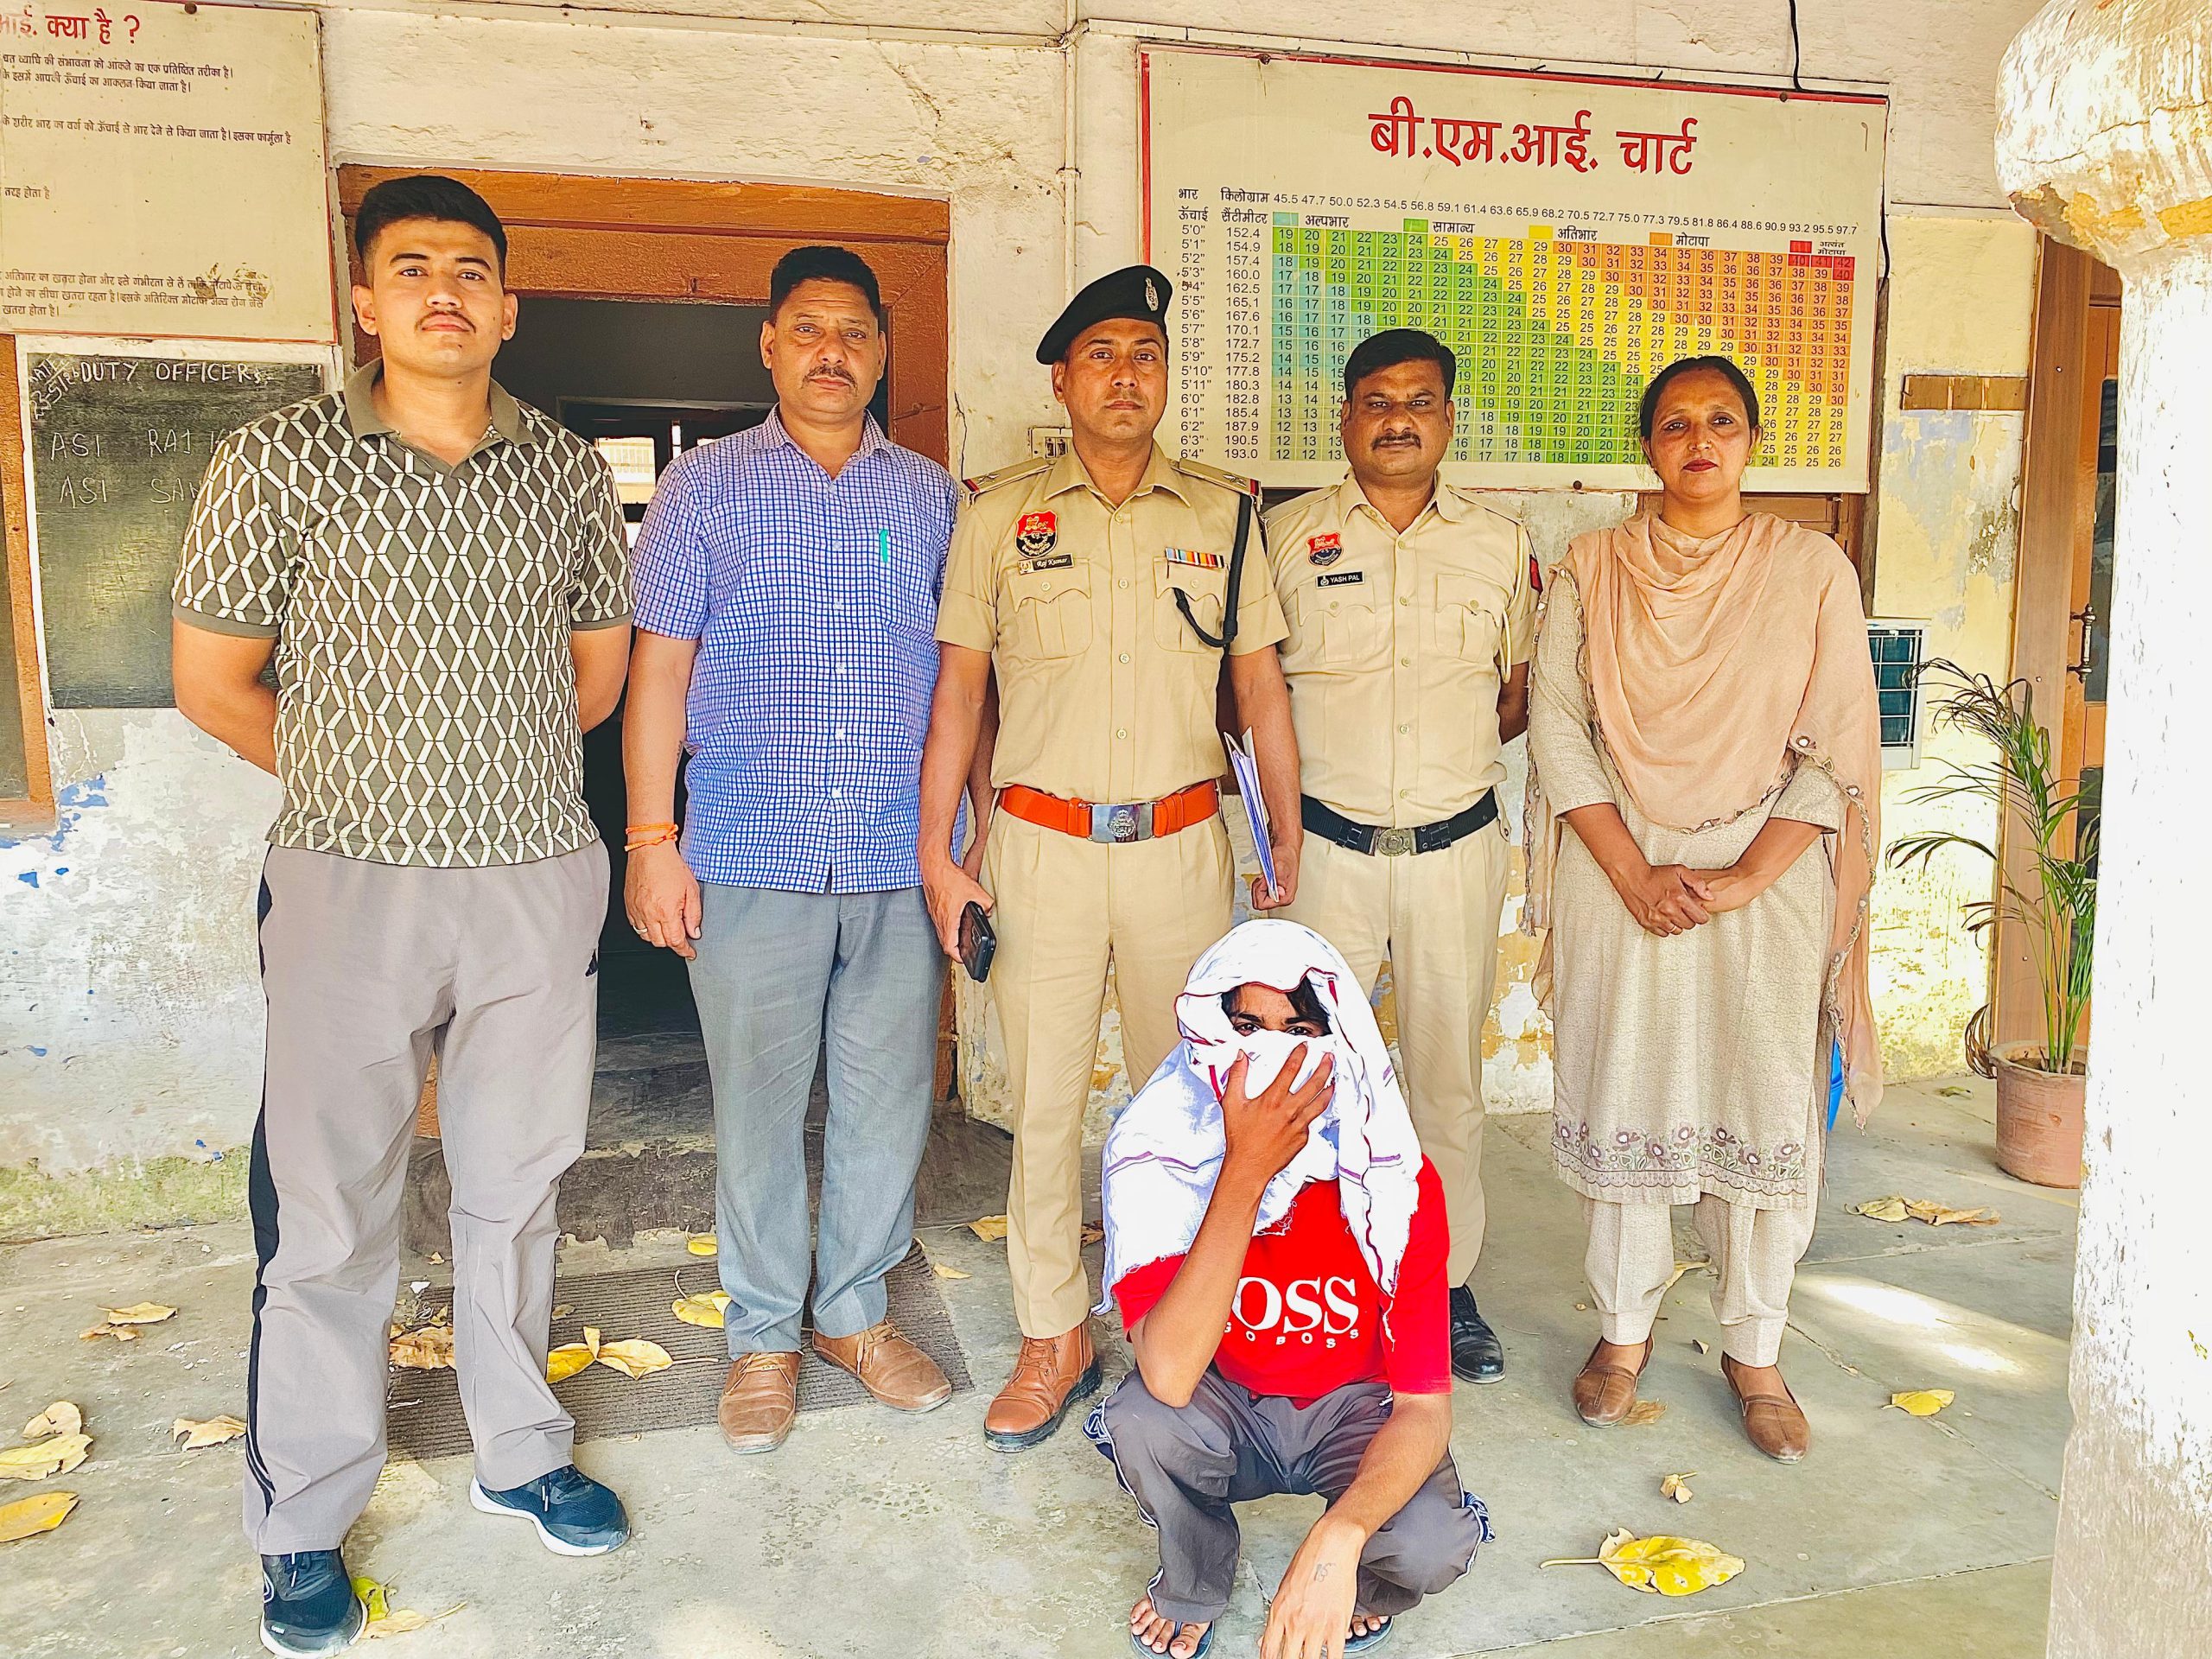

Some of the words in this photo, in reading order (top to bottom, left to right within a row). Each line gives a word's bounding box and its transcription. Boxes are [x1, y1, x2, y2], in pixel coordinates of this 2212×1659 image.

[45, 15, 90, 40] क्या
[94, 8, 112, 44] है
[124, 14, 140, 44] ?
[44, 53, 54, 66] की
[135, 63, 144, 73] का
[148, 65, 161, 74] एक
[197, 65, 221, 78] तरीका
[136, 77, 156, 90] किया
[159, 82, 178, 92] जाता
[166, 124, 173, 137] से
[176, 124, 196, 137] किया
[199, 130, 219, 139] जाता
[233, 132, 254, 143] इसका
[285, 130, 292, 145] है
[1368, 96, 1599, 173] बी.एम.आई.
[1616, 118, 1698, 175] चार्ट
[1179, 188, 1198, 200] भार
[1220, 188, 1270, 203] किलोग्राम
[1274, 194, 1298, 204] 45.5
[1301, 195, 1325, 206] 47.7
[1329, 196, 1353, 207] 50.0
[1357, 198, 1380, 208] 52.3
[1383, 200, 1408, 210] 54.5
[1410, 201, 1434, 211] 56.8
[1437, 202, 1459, 213] 59.1
[1464, 204, 1486, 214] 61.4
[1490, 206, 1512, 215] 63.6
[1516, 207, 1539, 217] 65.9
[1541, 208, 1564, 219] 68.2
[1567, 210, 1590, 220] 70.5
[1592, 212, 1615, 222] 72.7
[1618, 213, 1640, 223] 75.0
[1643, 214, 1665, 225] 77.3
[1668, 216, 1689, 226] 79.5
[1692, 217, 1713, 227] 81.8
[1716, 219, 1738, 229] 86.4
[1741, 220, 1762, 230] 88.6
[1764, 221, 1786, 232] 90.9
[1789, 223, 1810, 232] 93.2
[1813, 224, 1834, 234] 95.5
[1836, 226, 1857, 235] 97.7
[1305, 214, 1350, 228] अल्पभार
[1432, 221, 1476, 234] सामान्य
[1557, 226, 1599, 241] अतिभार
[1675, 232, 1710, 247] मोटापा
[1226, 227, 1260, 238] 152.4
[1279, 228, 1294, 238] 19
[1305, 230, 1319, 240] 20
[1332, 232, 1345, 242] 21
[1357, 232, 1371, 243] 22
[1382, 234, 1397, 244] 23
[1408, 235, 1423, 245] 24
[1433, 236, 1448, 246] 25
[1459, 238, 1473, 248] 26
[1484, 239, 1498, 249] 27
[1509, 240, 1523, 251] 28
[1534, 241, 1548, 251] 29
[1226, 241, 1260, 251] 154.9
[1226, 255, 1260, 265] 157.4
[1226, 269, 1260, 279] 160.0
[1226, 283, 1260, 293] 162.5
[1226, 296, 1260, 307] 165.1
[1226, 310, 1259, 321] 167.6
[1226, 324, 1259, 334] 170.1
[1226, 338, 1259, 348] 172.7
[1225, 352, 1259, 362] 175.2
[81, 361, 139, 383] DUTY
[1225, 366, 1259, 377] 177.8
[1225, 380, 1259, 391] 180.3
[1225, 394, 1258, 404] 182.8
[1225, 408, 1258, 418] 185.4
[1225, 422, 1258, 432] 187.9
[1225, 435, 1258, 446] 190.5
[50, 432, 101, 461] ASI
[1225, 449, 1258, 460] 193.0
[60, 475, 107, 509] ASI
[1231, 1275, 1359, 1334] OSS
[1275, 1329, 1359, 1348] BOSS
